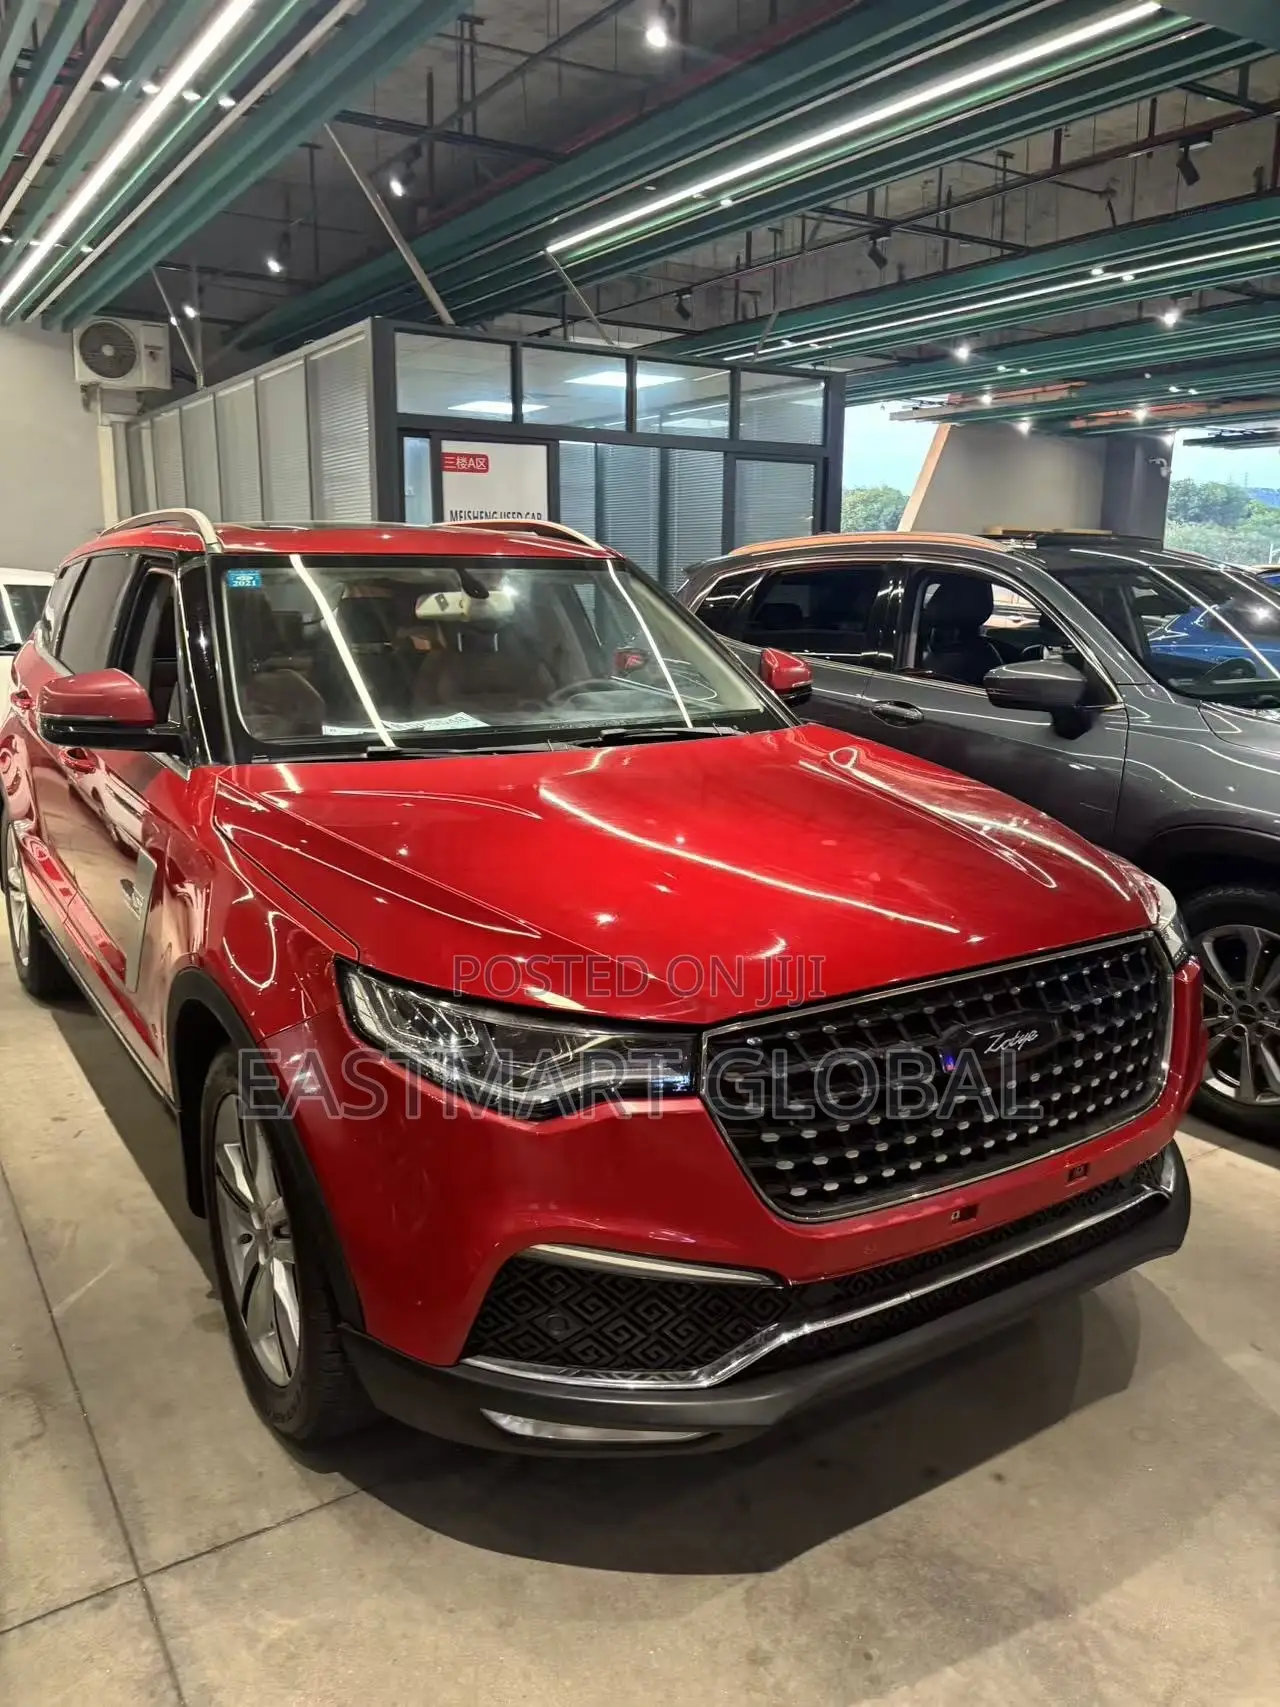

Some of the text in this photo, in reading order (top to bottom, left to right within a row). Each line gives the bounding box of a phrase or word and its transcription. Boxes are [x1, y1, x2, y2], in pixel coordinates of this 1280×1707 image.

[444, 455, 488, 470] 三楼A区
[232, 579, 257, 587] 2021
[983, 1029, 1039, 1054] Zotye
